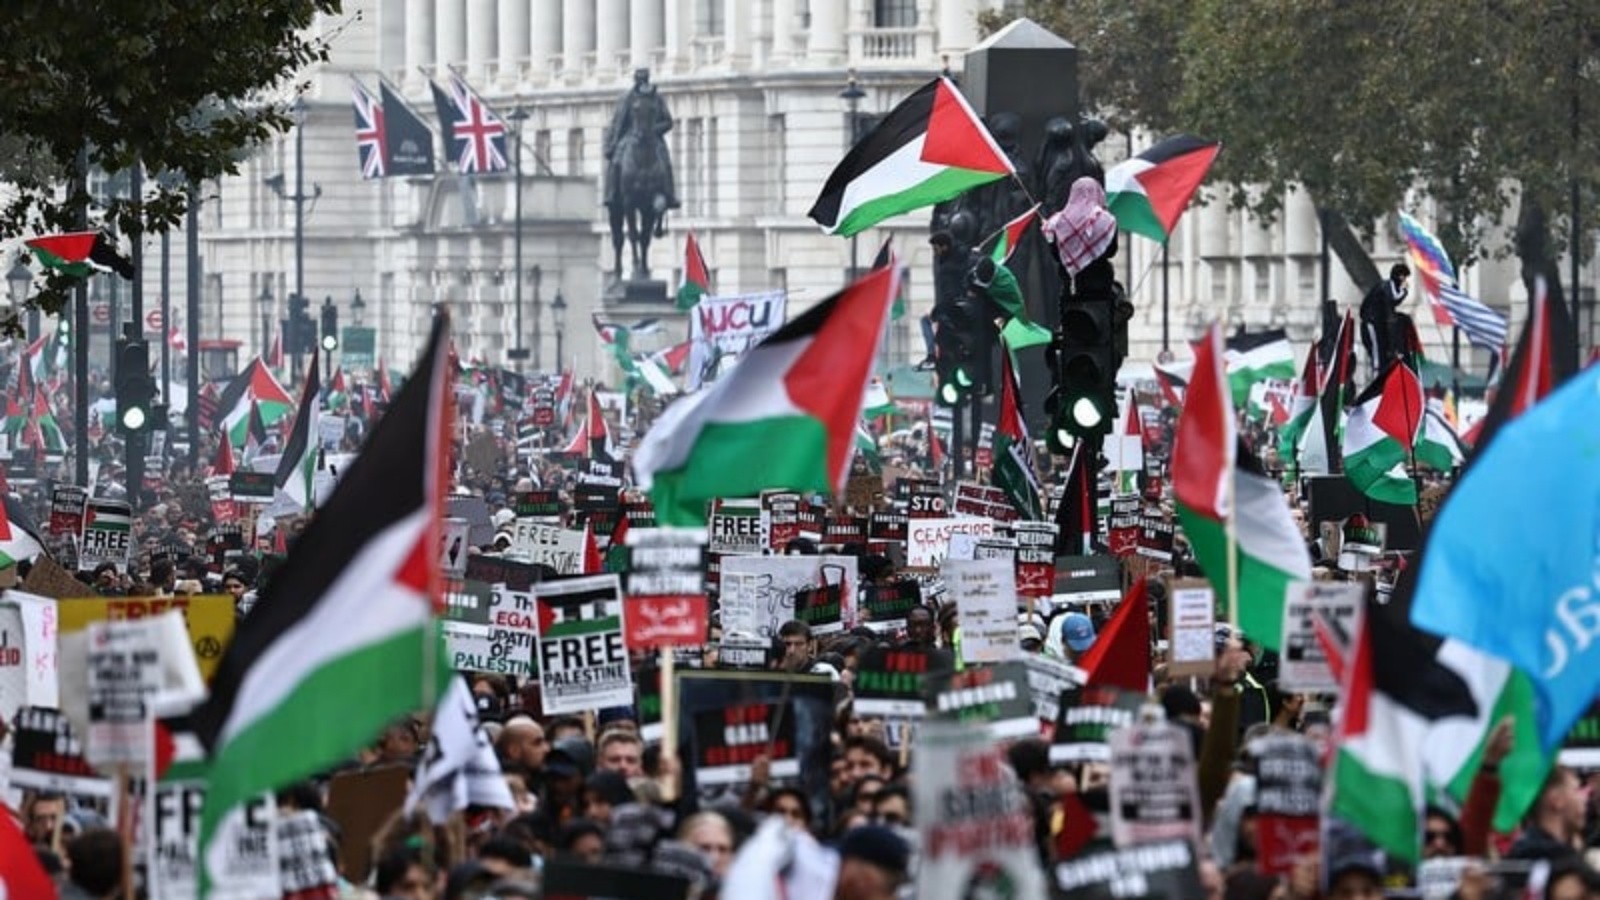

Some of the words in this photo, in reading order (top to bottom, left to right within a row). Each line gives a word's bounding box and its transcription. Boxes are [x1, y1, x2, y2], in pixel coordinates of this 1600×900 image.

[708, 301, 772, 334] UCU
[911, 495, 946, 511] STO
[712, 517, 761, 536] FREE
[874, 514, 908, 523] SANCTIO
[83, 532, 129, 551] FREE
[517, 526, 561, 545] FREE
[496, 611, 532, 629] EGA
[486, 630, 531, 648] UPATI
[490, 643, 513, 657] OF
[541, 632, 625, 671] FREE
[453, 652, 532, 673] PALESTIN
[543, 665, 626, 687] PALESTINE
[858, 671, 926, 692] PALEST
[154, 788, 269, 838] FRE
